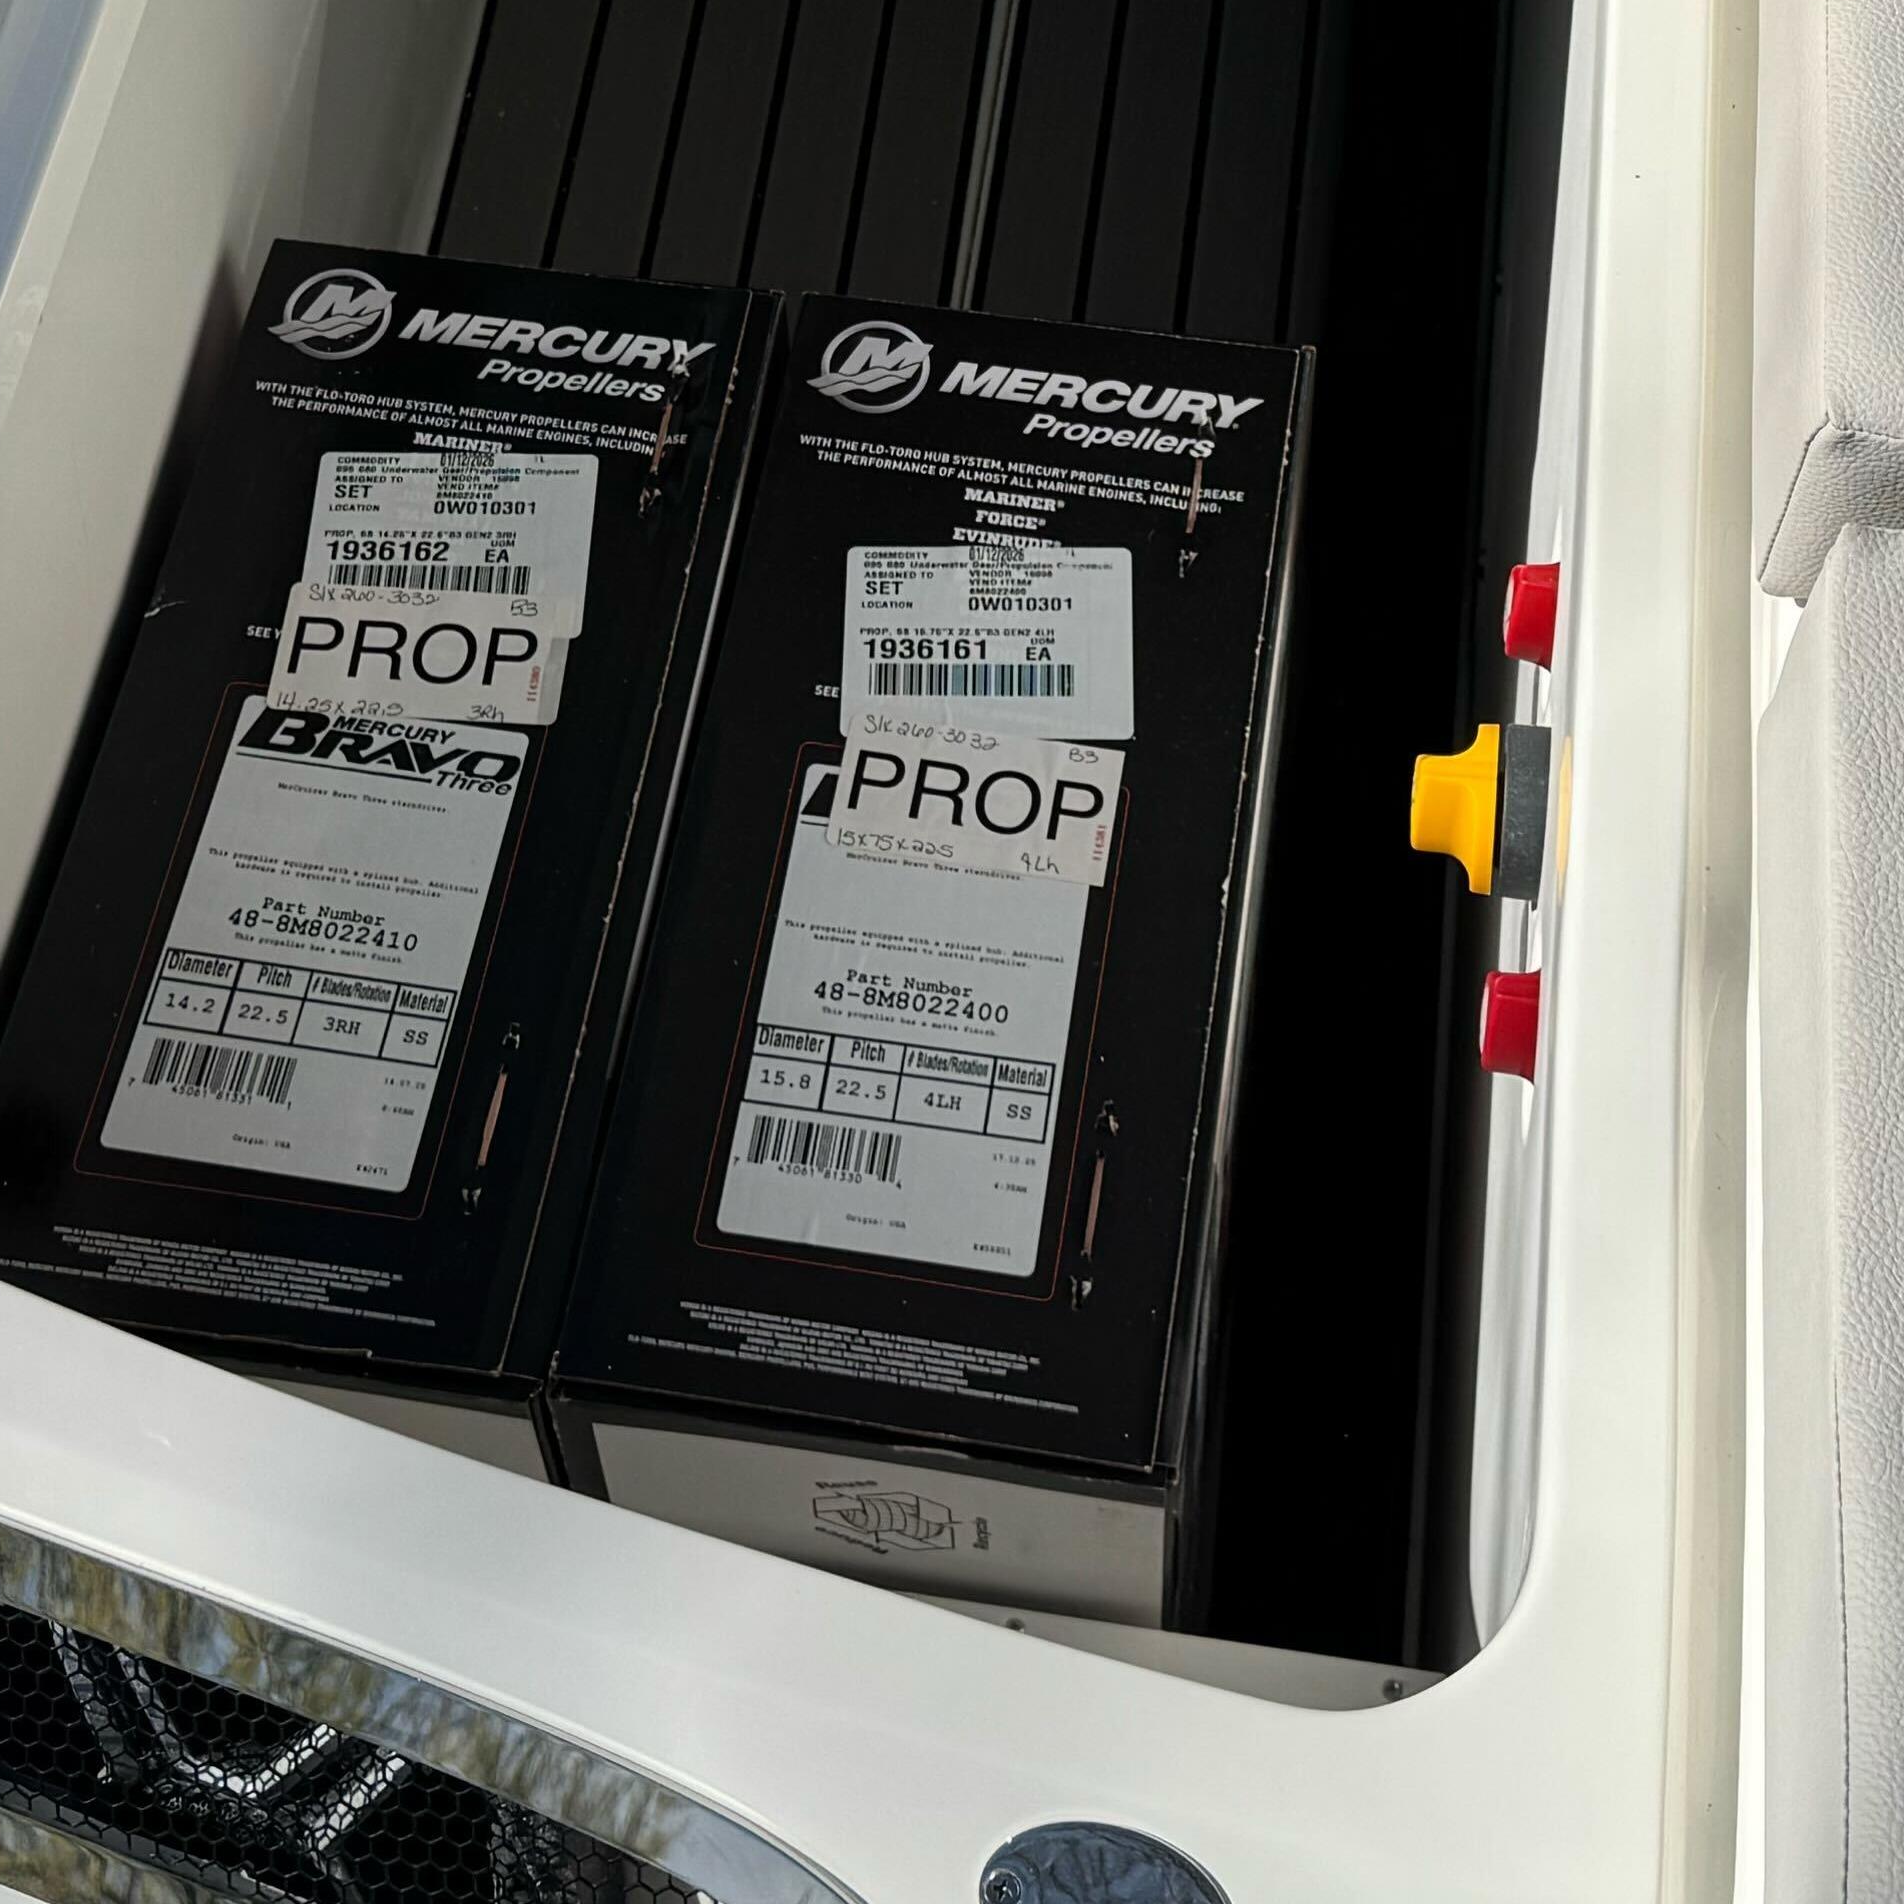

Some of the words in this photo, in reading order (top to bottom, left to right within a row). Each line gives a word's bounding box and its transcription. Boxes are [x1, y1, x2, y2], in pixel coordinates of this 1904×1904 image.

[398, 308, 716, 373] MERCURY
[477, 359, 665, 402] Propellers
[939, 361, 1264, 429] MERCURY
[255, 380, 287, 394] WITH
[290, 385, 314, 398] THE
[377, 398, 403, 409] HUB
[405, 400, 457, 417] SYSTEM,
[459, 406, 517, 424] MERCURY
[520, 414, 598, 433] PROPELLERS
[600, 424, 627, 437] CAN
[629, 427, 688, 445] INCRASE
[271, 396, 295, 408] THE
[297, 399, 388, 421] PERFORMANCE
[390, 411, 407, 423] OF
[408, 413, 458, 430] ALMOST
[460, 420, 483, 433] ALL
[486, 424, 534, 440] MARINE
[536, 430, 592, 447] ENGINES,
[596, 436, 656, 456] INCLUDIN
[1023, 413, 1216, 459] Propellers
[337, 456, 400, 465] COMMODITY
[391, 475, 404, 484] TO
[799, 434, 832, 448] WITH
[835, 438, 858, 452] THE
[923, 450, 950, 464] HUB
[952, 454, 1005, 472] SYSTEM,
[1007, 462, 1068, 479] MERCURY
[1070, 470, 1151, 491] PROPELLERS
[1153, 481, 1180, 495] CAN
[817, 449, 840, 463] THE
[843, 453, 936, 476] PERFORMANCE
[939, 466, 956, 478] OF
[957, 468, 1008, 485] ALMOST
[1010, 476, 1034, 489] ALL
[1037, 479, 1086, 496] MARINE
[1088, 486, 1147, 505] ENGINES,
[329, 504, 380, 512] LOCATION
[334, 484, 373, 499] SET
[326, 540, 450, 562] 1936162
[484, 548, 510, 563] EA
[864, 551, 928, 560] COMMODITY
[861, 600, 913, 609] LOCATION
[865, 580, 904, 596] SET
[247, 624, 272, 639] SEE
[287, 615, 539, 686] PROP
[863, 638, 987, 660] 1936161
[1026, 647, 1052, 661] EA
[814, 684, 840, 698] SEE
[238, 709, 522, 783] BRAVO
[333, 716, 456, 745] MERCURY
[436, 770, 513, 797] Three
[847, 749, 1104, 841] PROP
[228, 907, 419, 953] 48-8M8022410
[263, 896, 306, 916] Part
[317, 904, 386, 928] Number
[167, 949, 233, 980] Diameter
[257, 963, 293, 989] Pitch
[319, 977, 392, 1004] Blades/Rotation
[398, 987, 449, 1014] Material
[813, 981, 1010, 1024] 48-8M8022400
[846, 969, 891, 988] Part
[904, 976, 974, 998] Number
[164, 994, 216, 1015] 14.2
[237, 1003, 289, 1025] 22.5
[322, 1016, 361, 1037] 3RH
[402, 1029, 429, 1047] SS
[758, 1025, 826, 1054] Diameter
[851, 1041, 886, 1064] Pitch
[916, 1051, 990, 1079] Blades/Rotation
[997, 1063, 1048, 1088] Material
[760, 1069, 812, 1090] 15.8
[836, 1079, 887, 1100] 22.5
[923, 1092, 962, 1112] 4LH
[1006, 1104, 1033, 1121] SS
